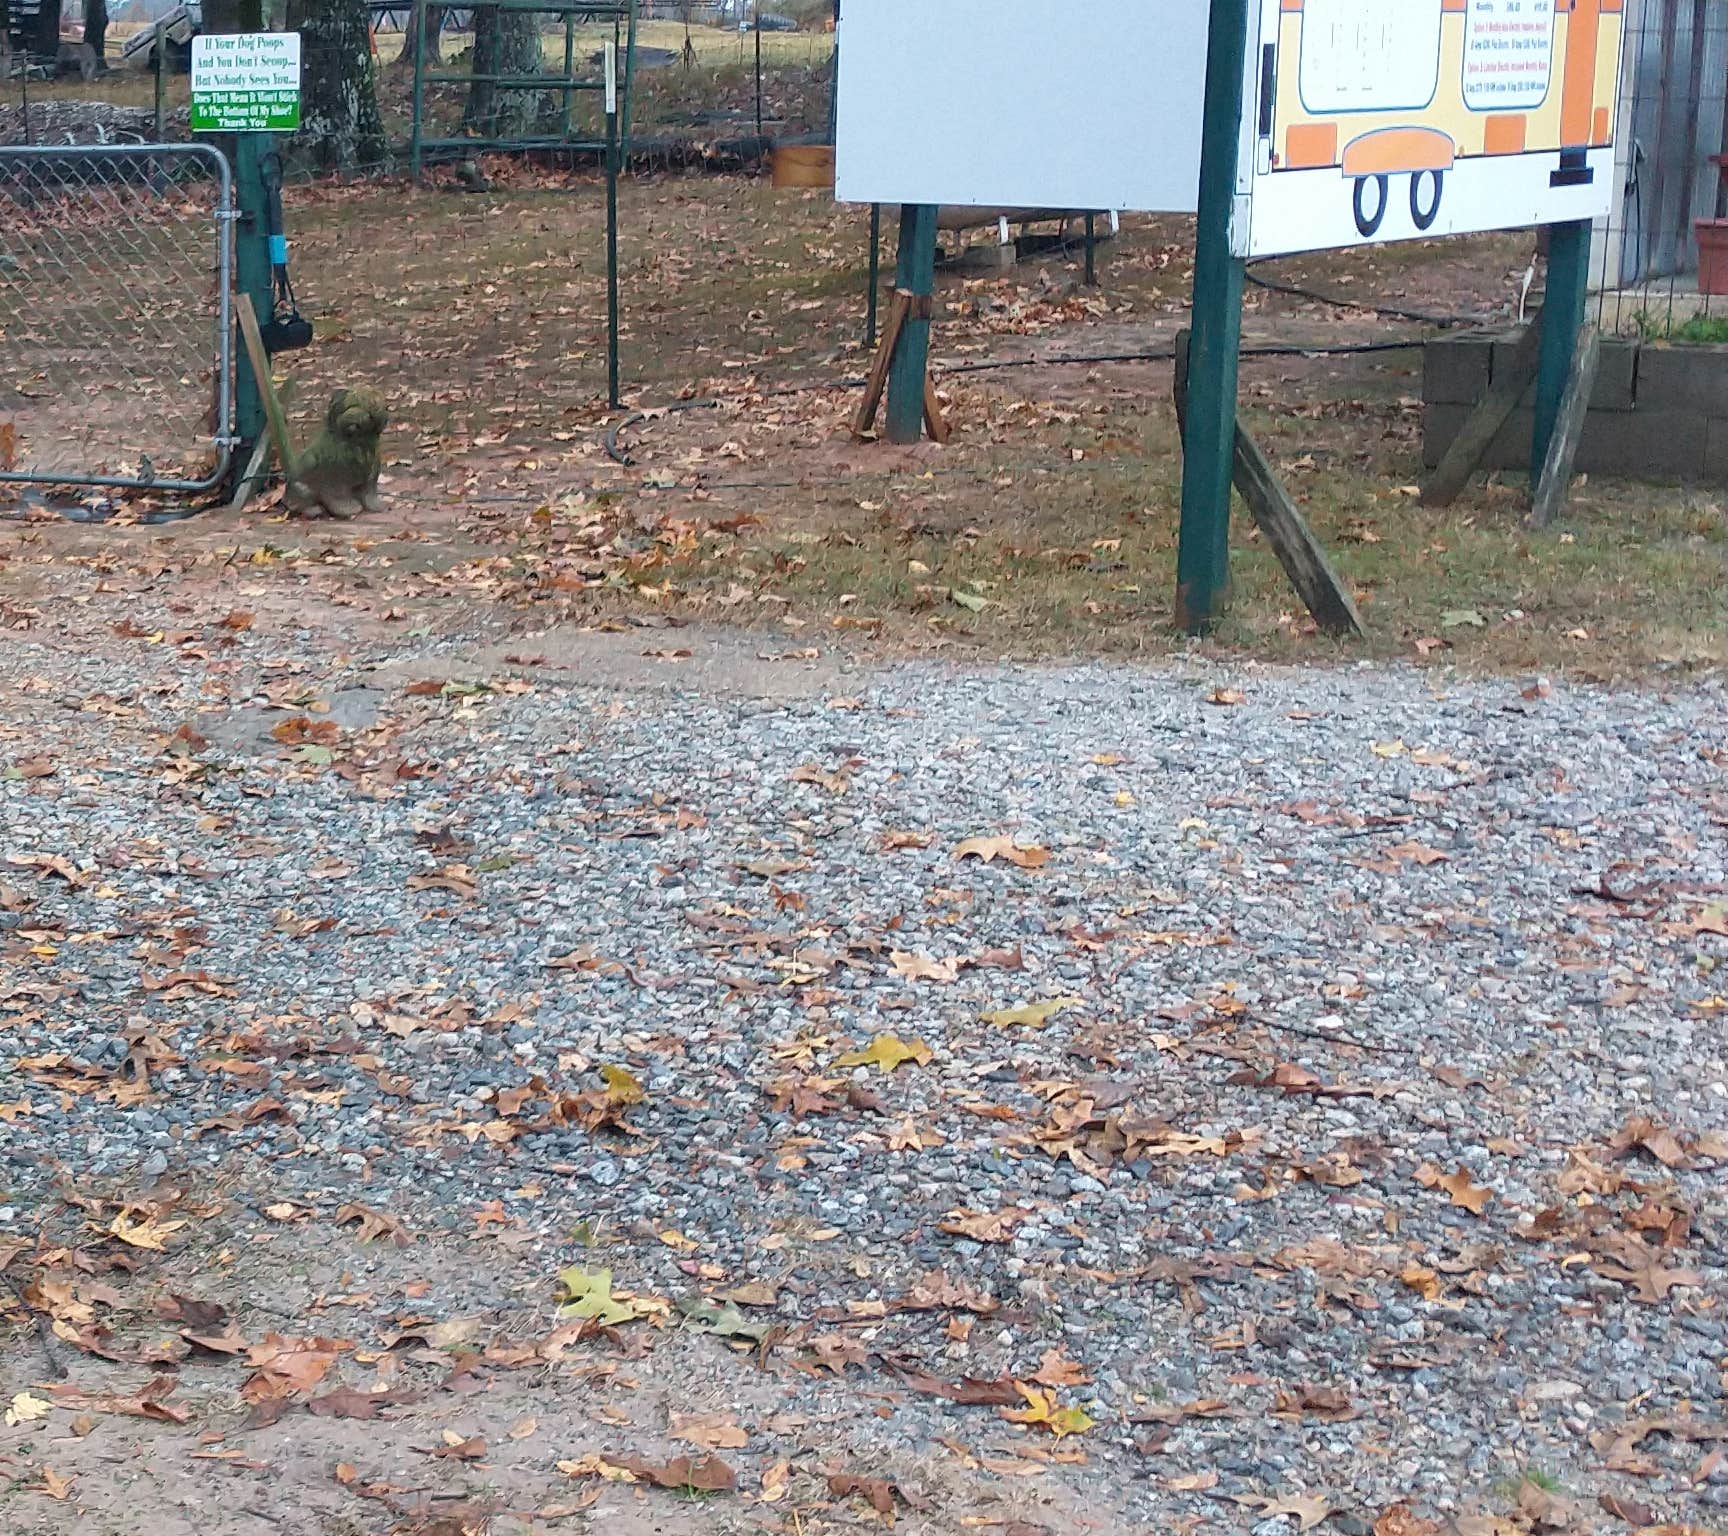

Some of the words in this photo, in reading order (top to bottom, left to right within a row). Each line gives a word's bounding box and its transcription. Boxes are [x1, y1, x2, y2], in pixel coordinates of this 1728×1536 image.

[215, 37, 235, 49] Your
[238, 36, 255, 51] Dog
[257, 36, 284, 51] Poops
[198, 55, 213, 68] And
[216, 55, 232, 67] You
[236, 55, 258, 67] Don't
[195, 73, 211, 86] But
[214, 73, 245, 88] Nobody
[249, 73, 270, 85] Sees
[212, 92, 228, 103] That
[199, 105, 208, 117] To
[209, 105, 222, 117] The
[223, 105, 249, 116] Bottom
[250, 104, 259, 116] Of
[259, 105, 270, 118] My
[218, 118, 247, 127] Thank
[250, 118, 267, 127] You
